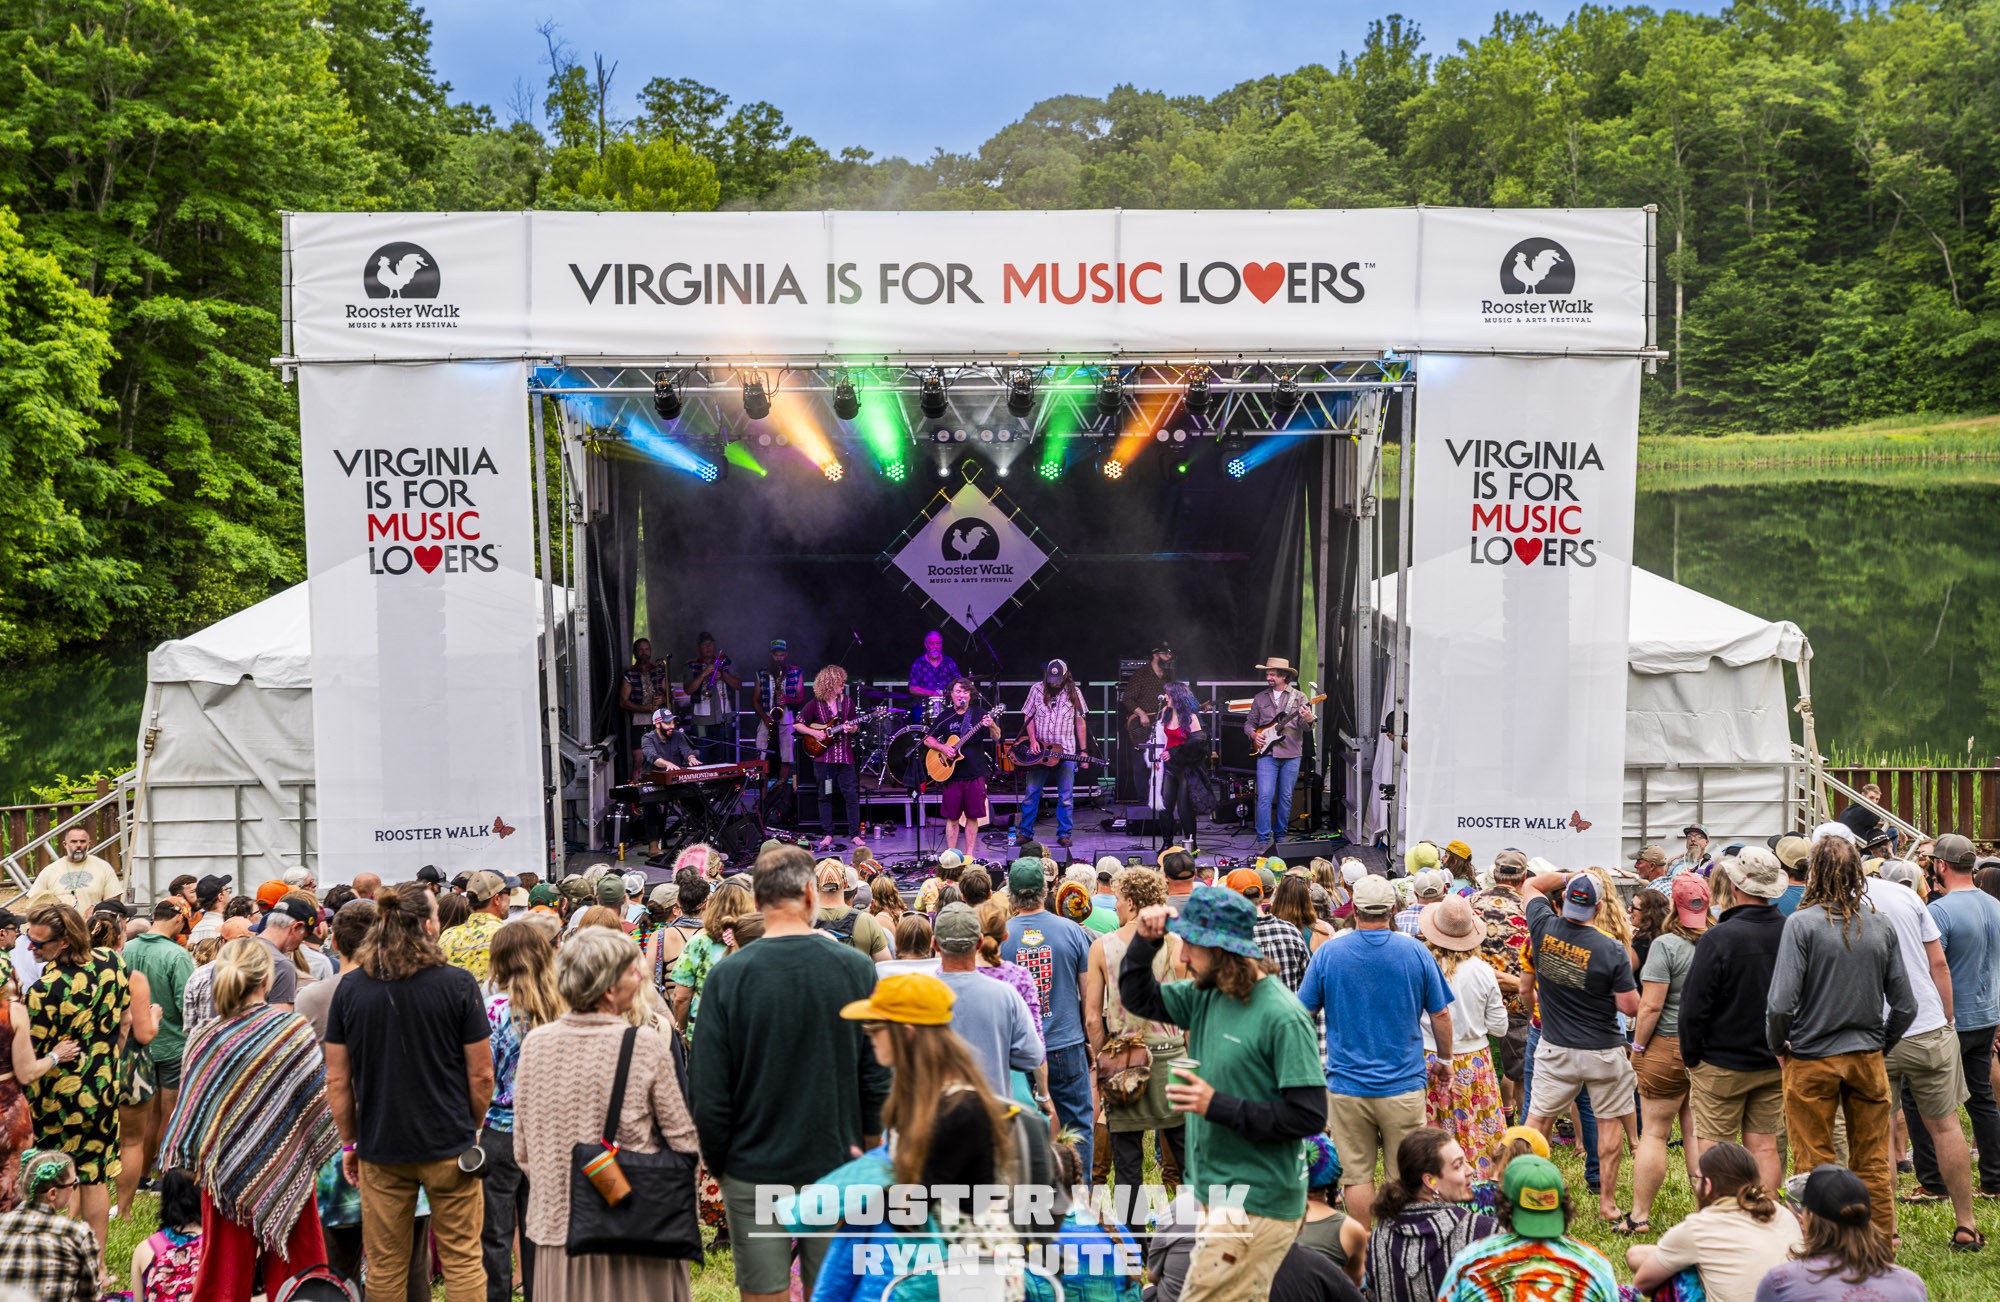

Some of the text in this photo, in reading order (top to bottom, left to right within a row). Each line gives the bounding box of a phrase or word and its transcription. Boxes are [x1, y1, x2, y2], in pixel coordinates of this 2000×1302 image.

[567, 262, 808, 306] VIRGINIA
[826, 262, 863, 305] IS
[879, 261, 985, 306] FOR
[1003, 261, 1163, 305] MUSIC
[345, 304, 460, 319] Rooster Walk
[1481, 299, 1594, 314] Rooster Walk
[415, 321, 458, 329] FESTIVAL
[332, 446, 499, 478] VIRGINIA
[1444, 438, 1605, 473] VIRGINIA
[366, 478, 477, 510] IS FOR
[1473, 470, 1580, 502] IS FOR
[367, 510, 481, 542] MUSIC
[1471, 503, 1582, 535] MUSIC
[927, 563, 1014, 576] Rooster Walk
[374, 824, 490, 842] ROOSTER WALK
[1457, 816, 1567, 830] ROOSTER WALK
[1542, 934, 1592, 960] HEALING
